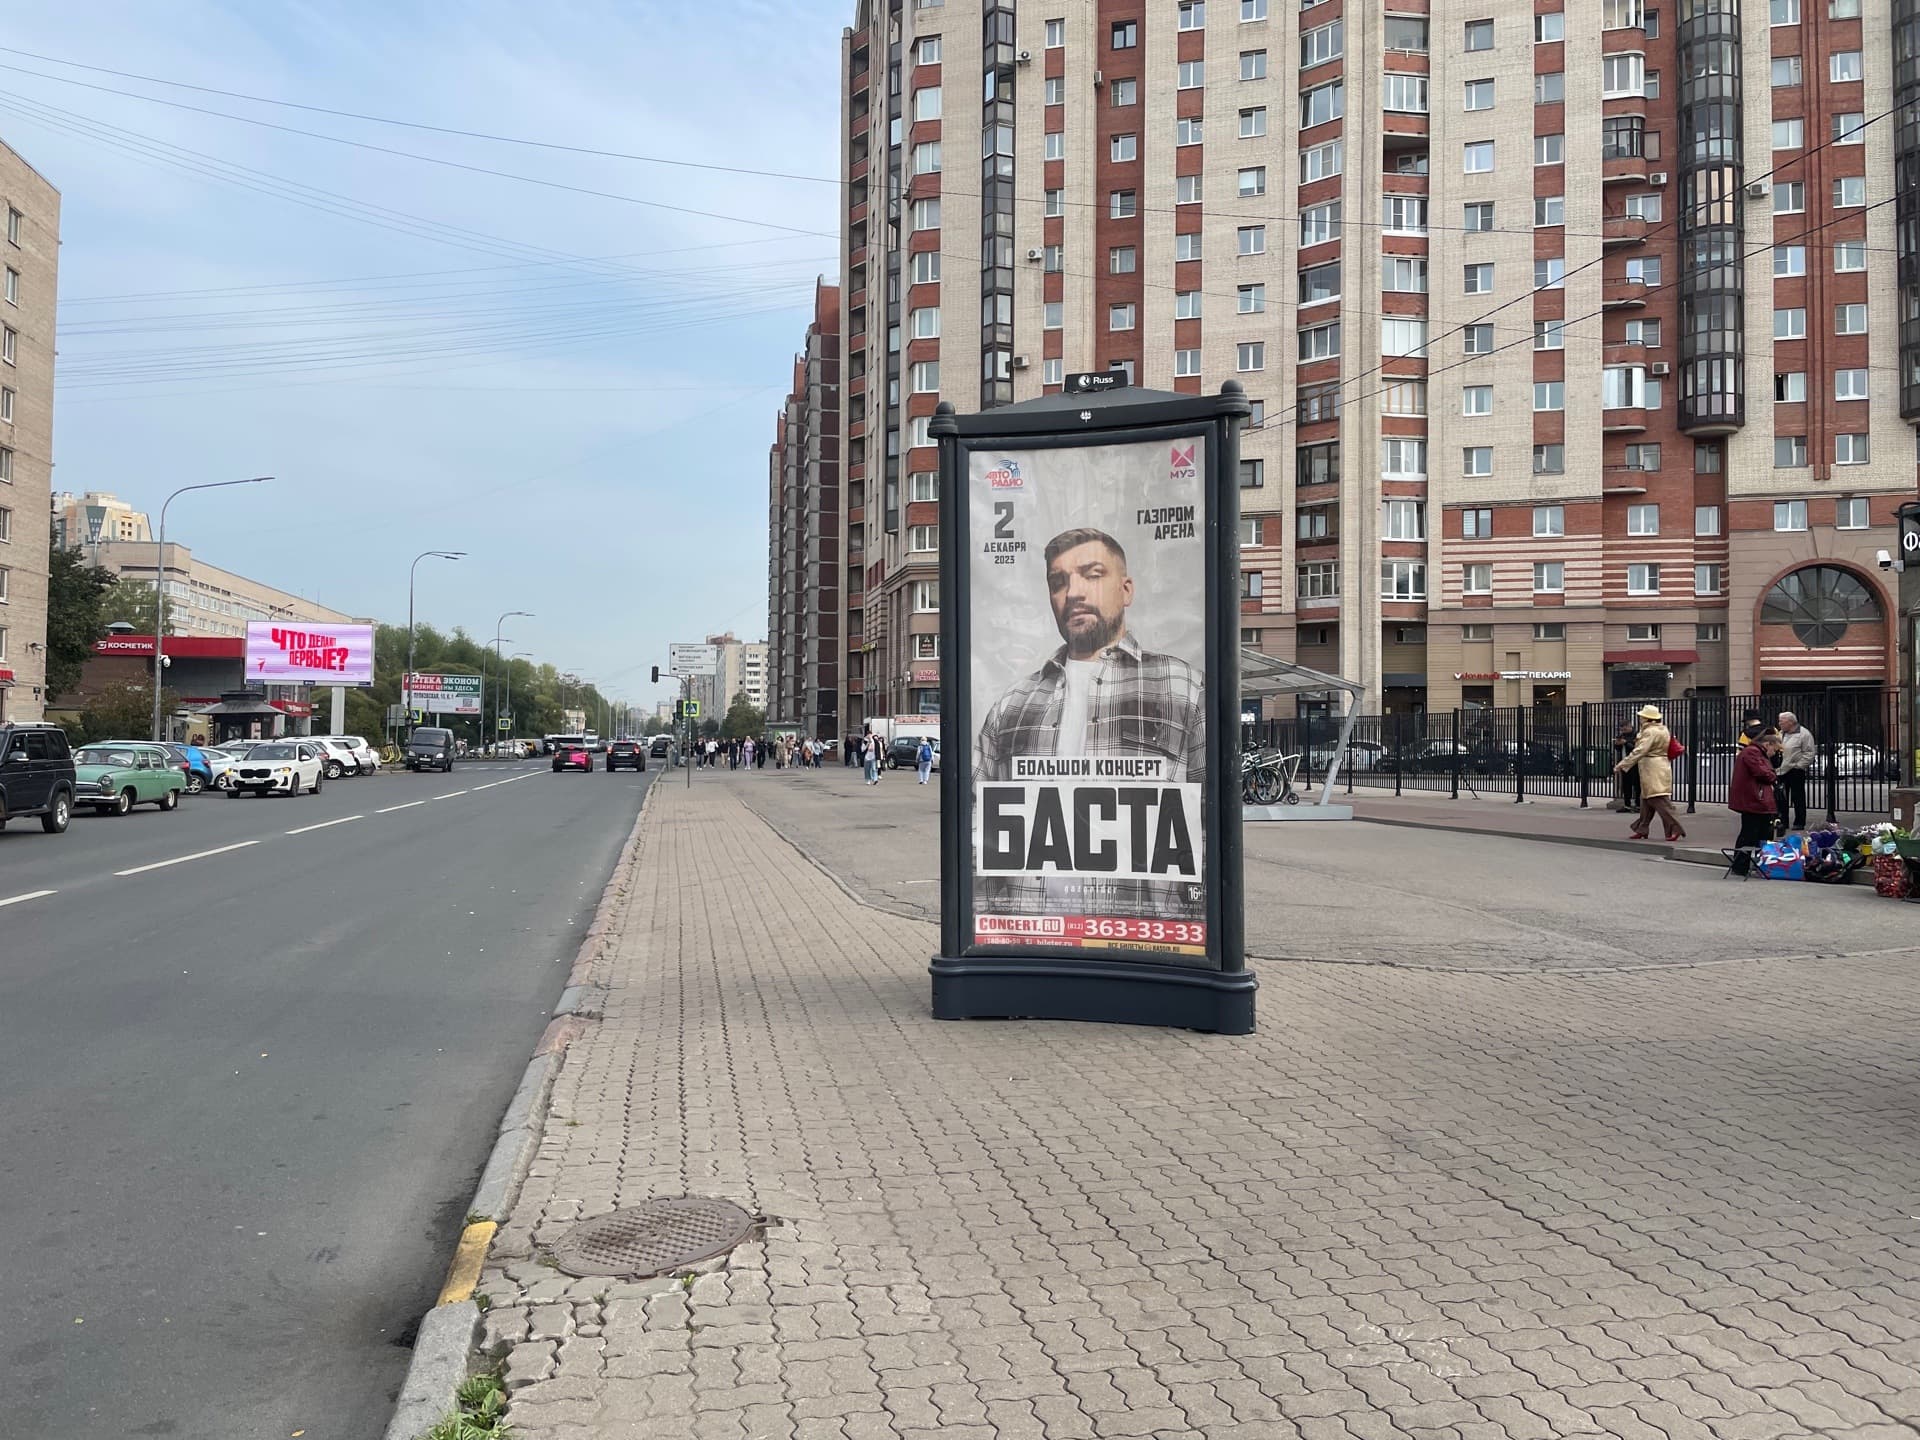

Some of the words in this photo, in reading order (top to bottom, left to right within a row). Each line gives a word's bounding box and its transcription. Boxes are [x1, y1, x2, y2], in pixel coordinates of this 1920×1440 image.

[1093, 376, 1114, 385] Russ
[1170, 469, 1196, 479] МУЗ
[991, 478, 1024, 487] РАДИО
[994, 501, 1015, 539] 2
[1137, 505, 1195, 525] ГАЗПРОМ
[1154, 523, 1195, 540] АРЕНА
[984, 541, 1027, 553] ДЕКАБРЯ
[994, 555, 1015, 565] 2023
[271, 627, 307, 650] ЧТО
[107, 642, 154, 650] КОСМЕТИК
[289, 647, 350, 672] ПЕРВЫЕ?
[443, 677, 480, 685] ЭКОНОМ
[1529, 671, 1572, 679] ПЕКАРНЯ
[1016, 758, 1091, 776] БОЛЬШОЙ
[1096, 759, 1162, 777] КОНЦЕРТ
[982, 786, 1196, 875] БАСТА
[1188, 886, 1203, 900] 16+
[979, 917, 1061, 934] CONCERT.RU
[1084, 918, 1203, 943] 363-33-33
